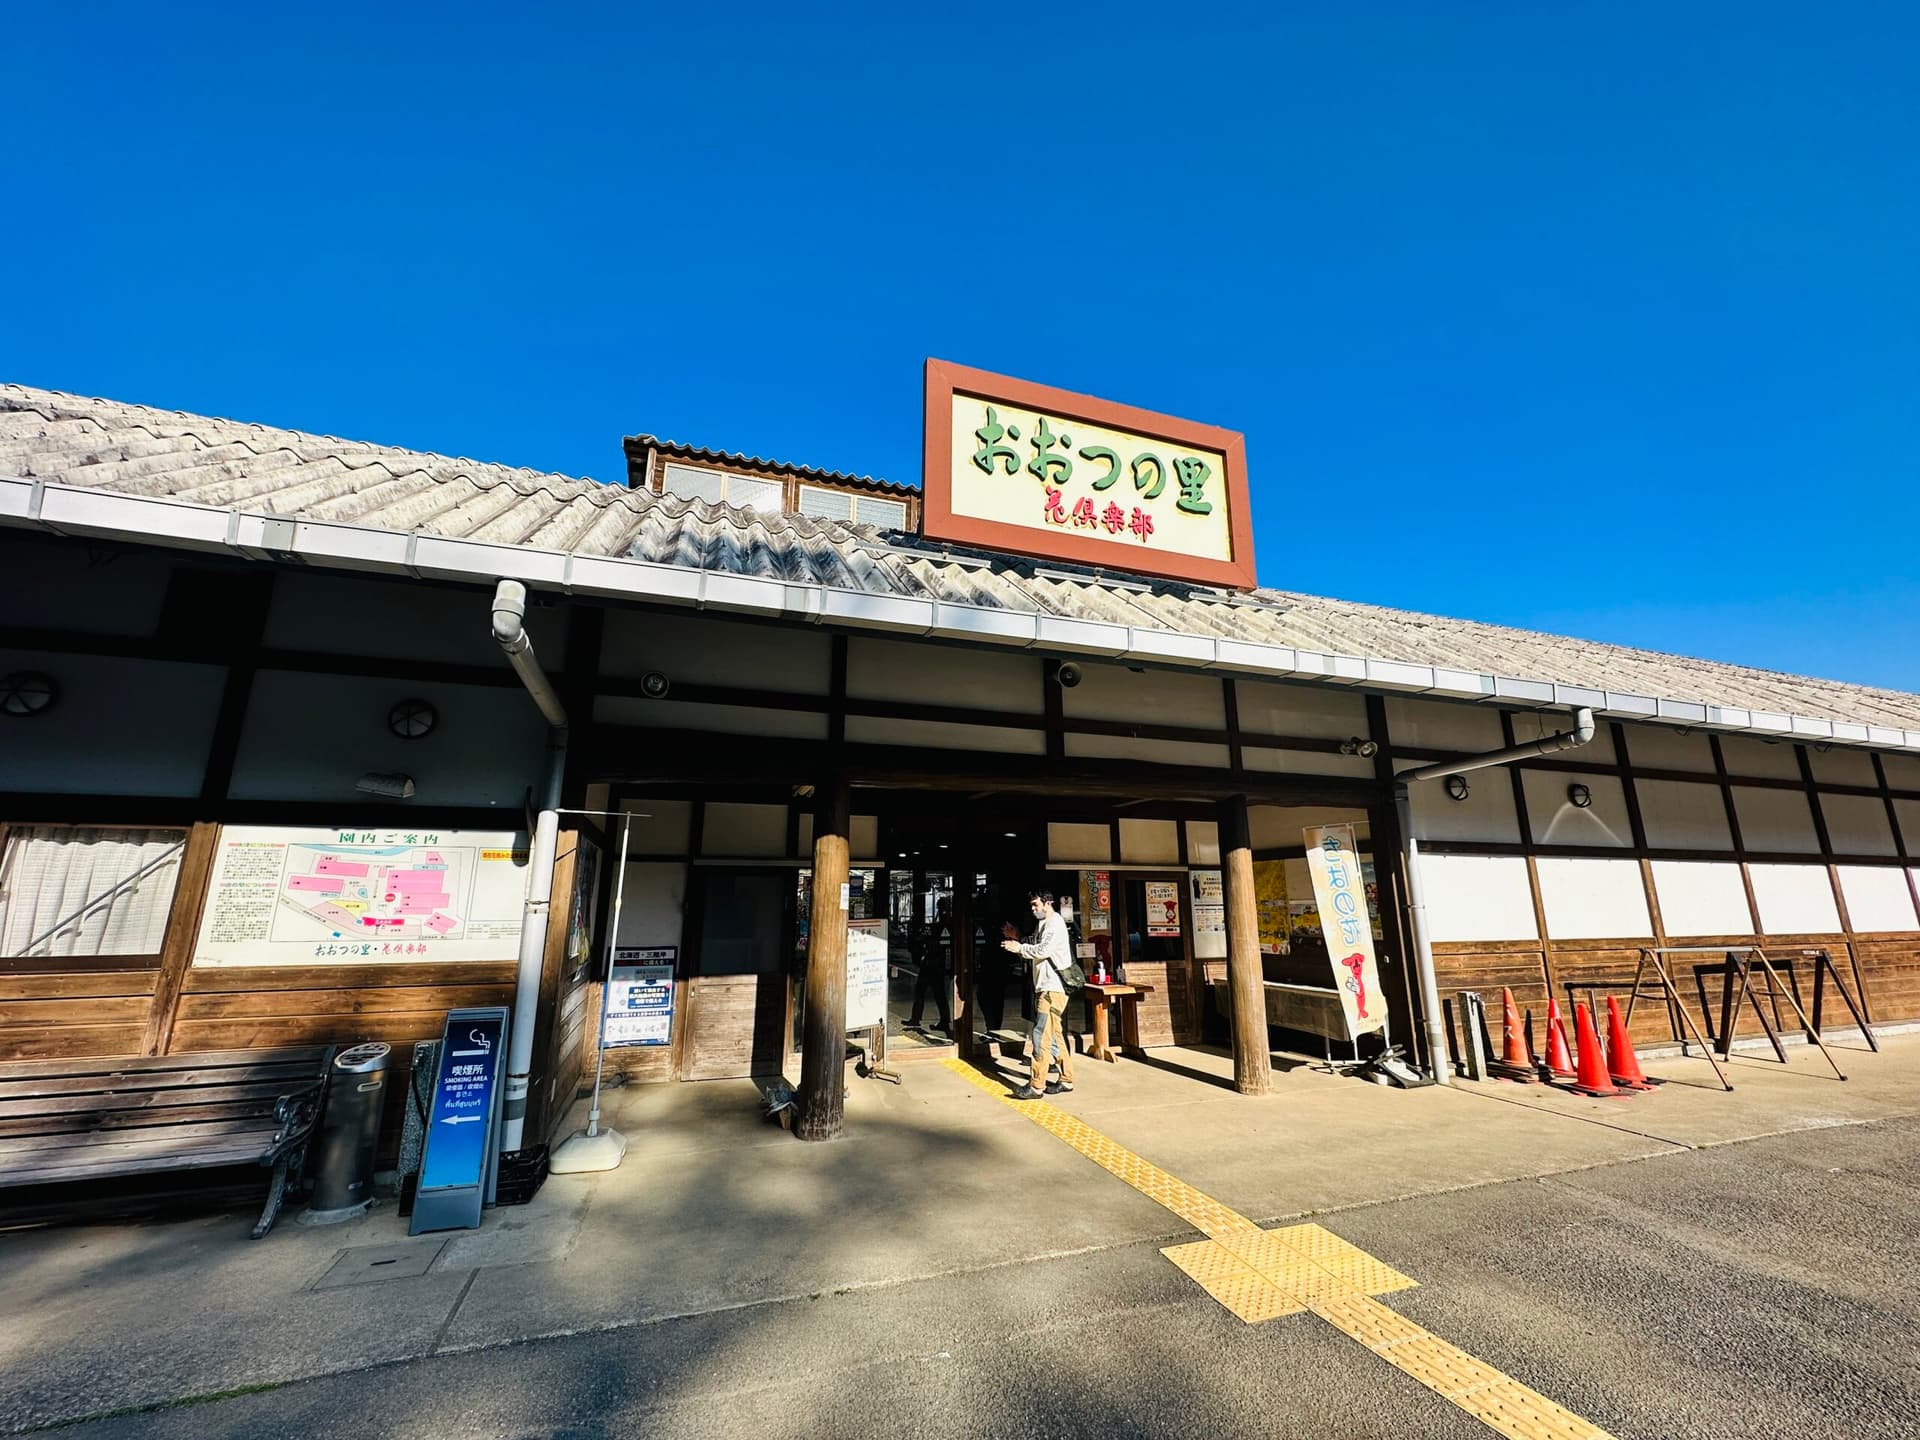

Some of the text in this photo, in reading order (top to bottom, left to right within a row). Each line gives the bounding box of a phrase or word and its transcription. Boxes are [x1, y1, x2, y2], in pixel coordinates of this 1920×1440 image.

[973, 406, 1213, 515] おおつの里
[1044, 486, 1155, 542] 花倶楽部
[445, 1076, 472, 1084] SMOKING
[452, 1064, 484, 1076] 喫煙所
